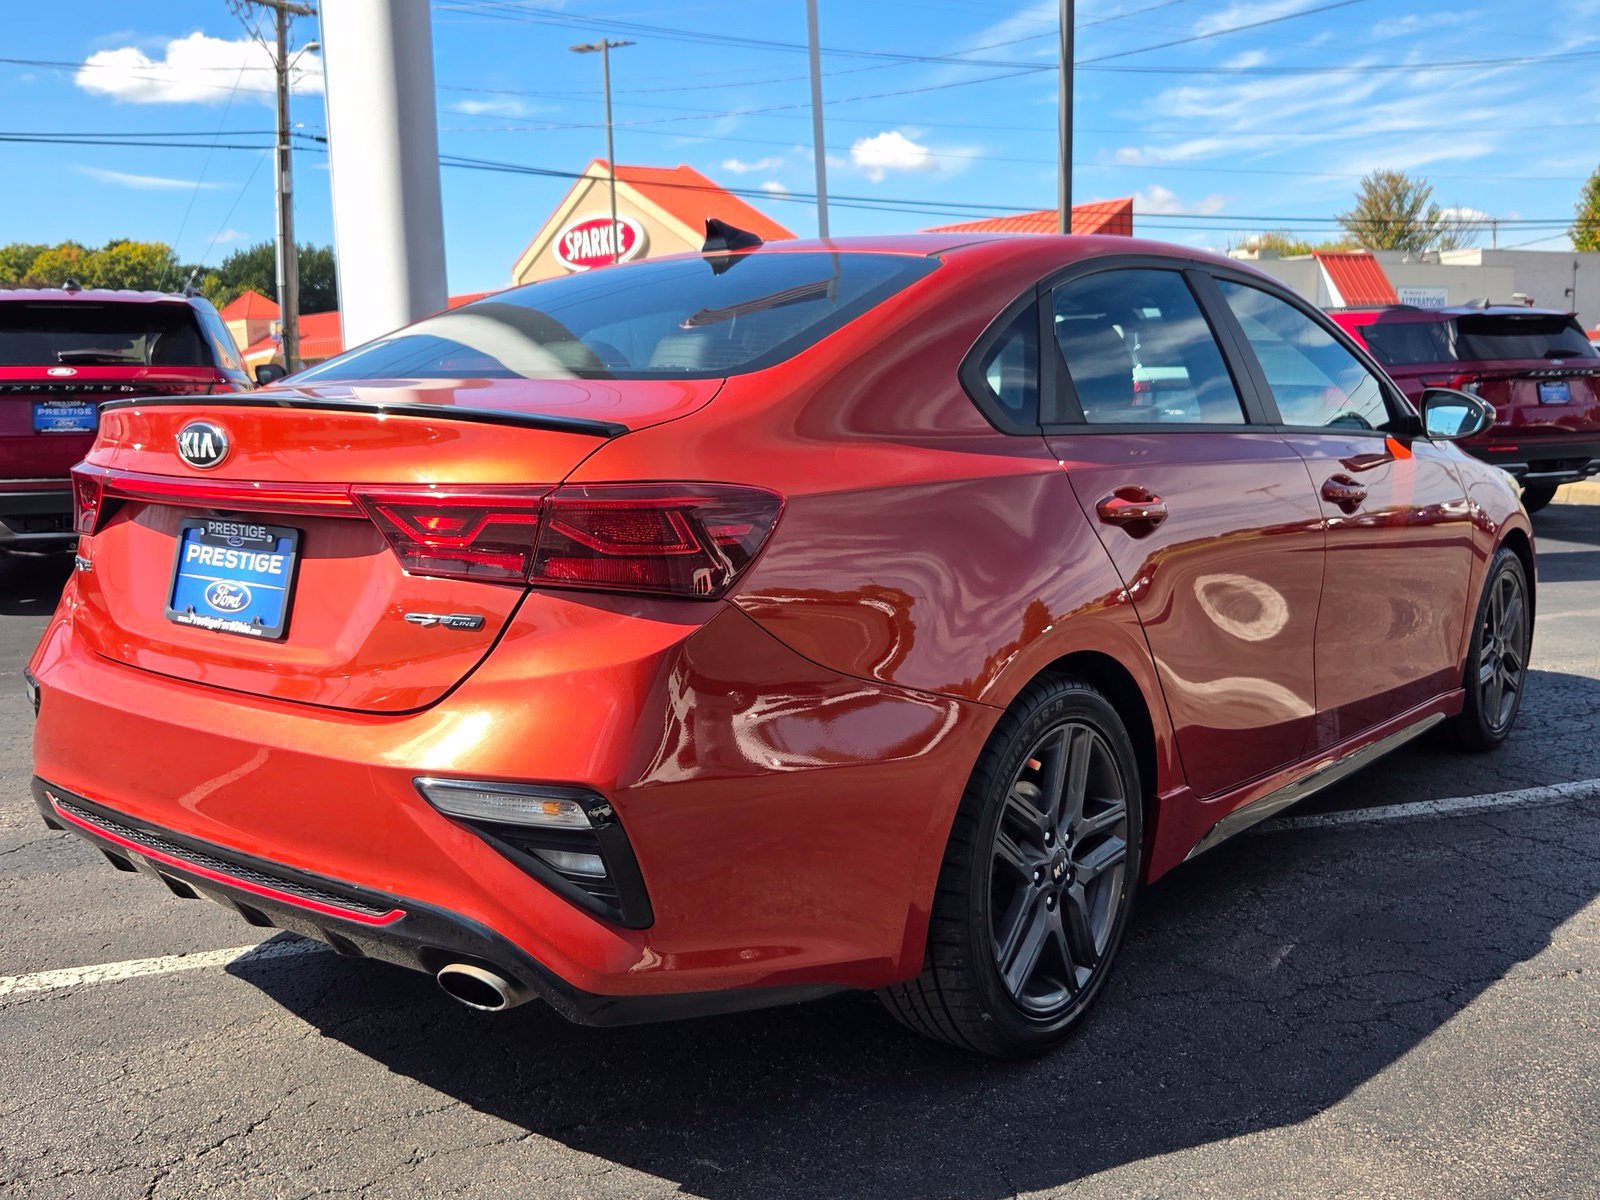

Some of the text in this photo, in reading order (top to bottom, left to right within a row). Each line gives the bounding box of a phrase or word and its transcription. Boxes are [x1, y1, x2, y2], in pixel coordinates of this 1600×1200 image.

[37, 408, 92, 416] PRESTIGE
[180, 431, 217, 459] KIA
[208, 521, 267, 540] PRESTIGE
[186, 544, 284, 575] PRESTIGE
[212, 584, 242, 609] Ford
[452, 620, 477, 628] LINE
